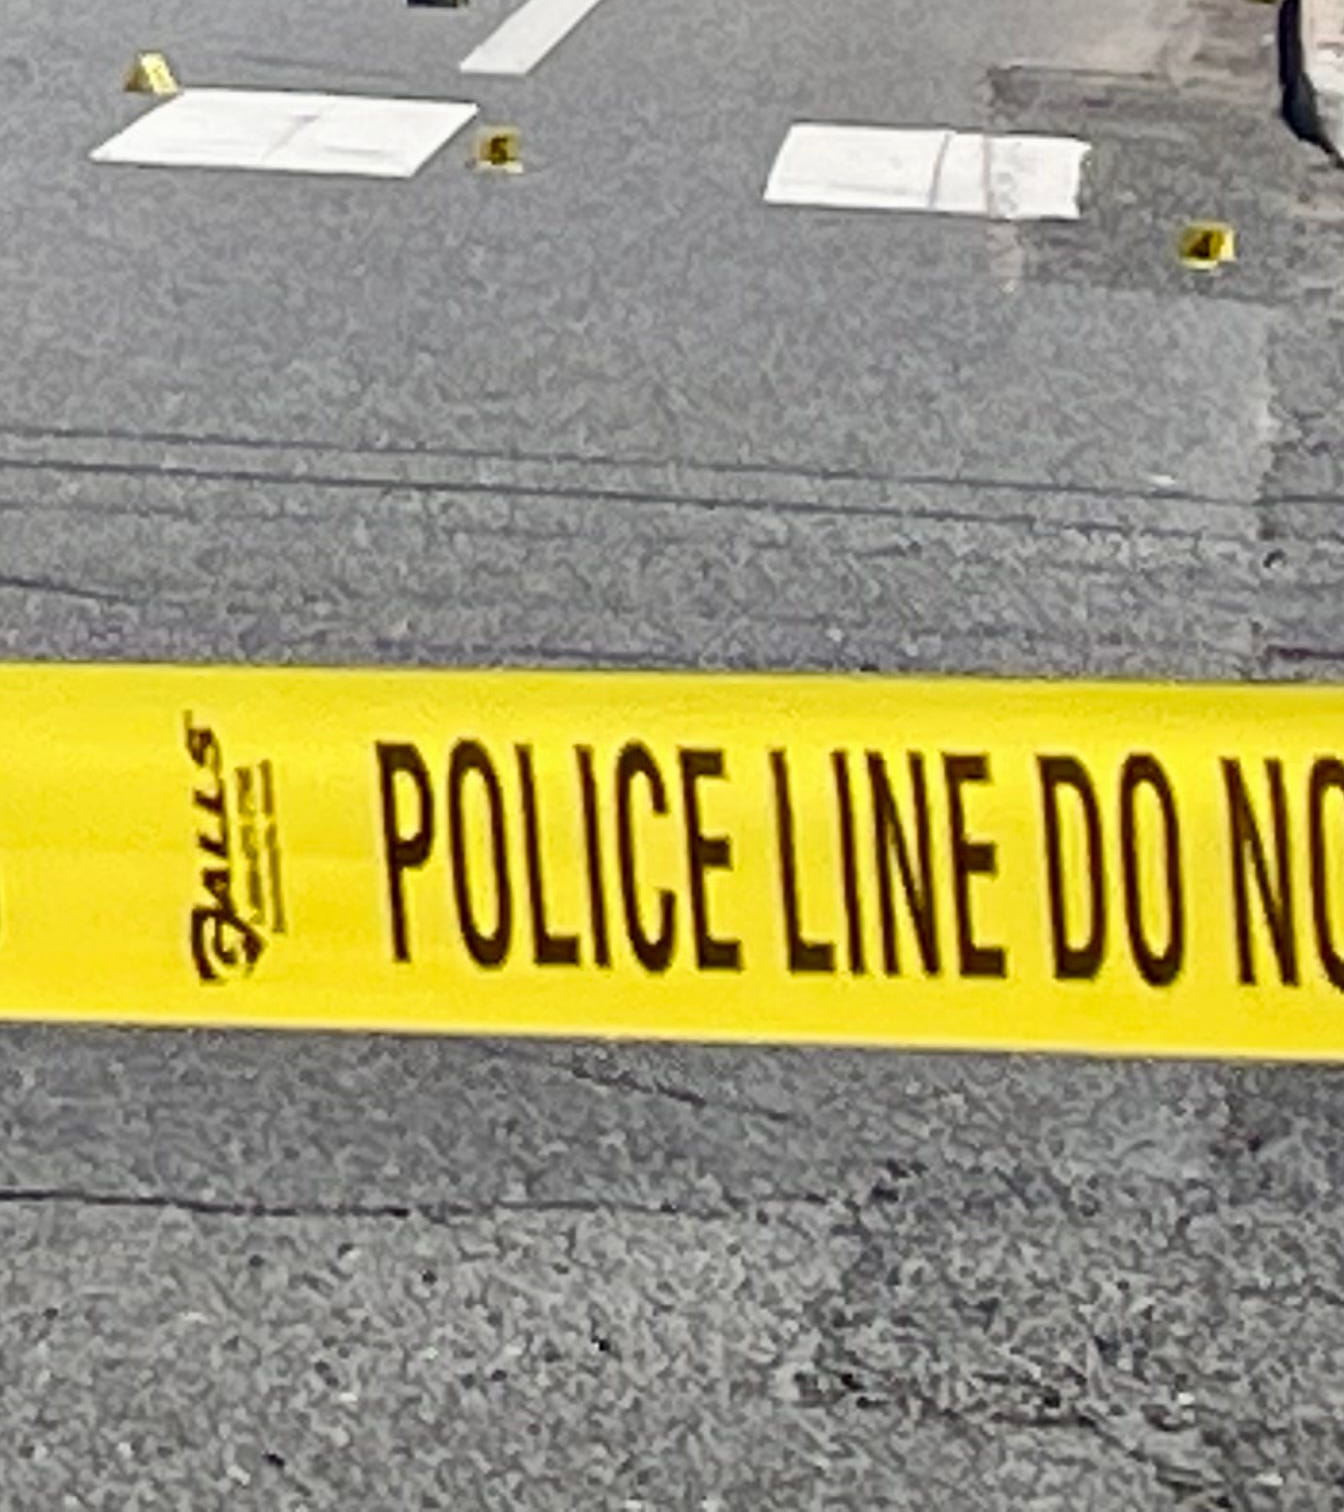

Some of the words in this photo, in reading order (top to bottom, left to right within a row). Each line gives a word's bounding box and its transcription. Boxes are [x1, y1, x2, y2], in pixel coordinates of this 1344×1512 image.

[376, 742, 741, 973] POLICE
[770, 751, 1007, 979] LINE
[1037, 754, 1185, 987] DO
